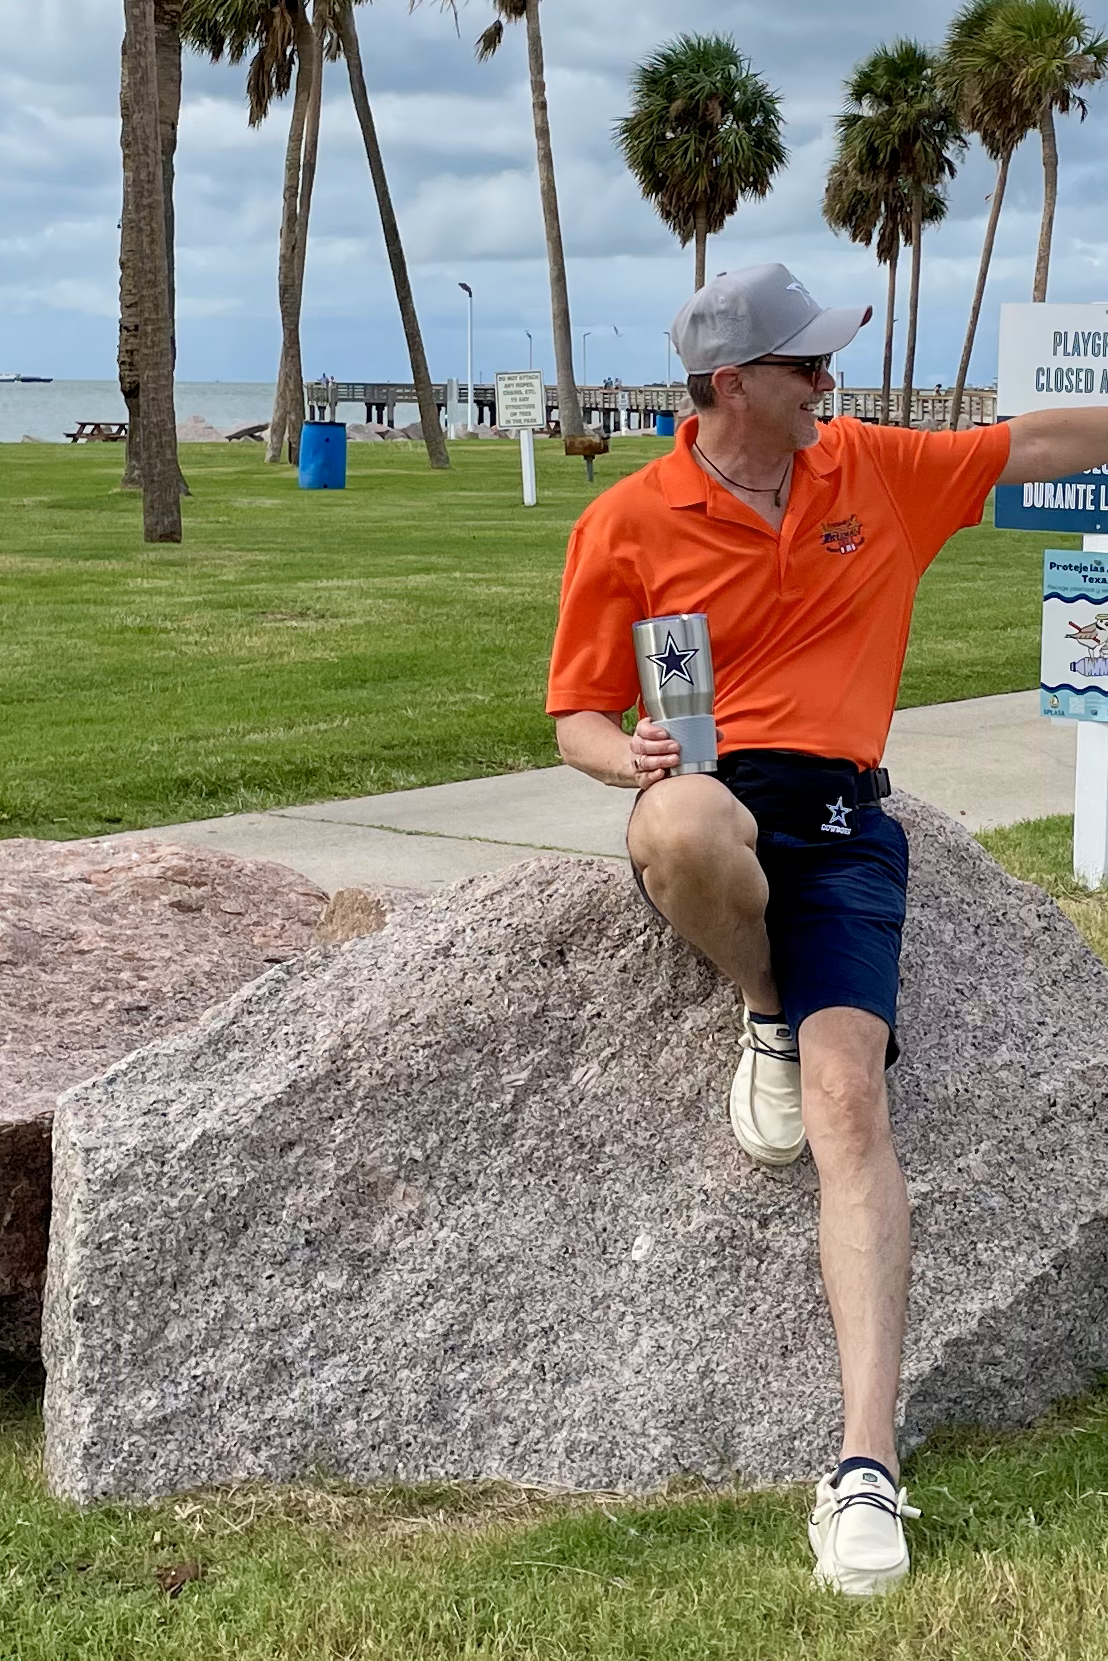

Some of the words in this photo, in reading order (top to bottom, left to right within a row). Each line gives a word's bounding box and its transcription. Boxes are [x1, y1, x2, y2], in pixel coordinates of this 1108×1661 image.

[1035, 366, 1095, 394] CLOSED
[1022, 482, 1096, 511] DURANTE
[1049, 561, 1088, 574] Proteje
